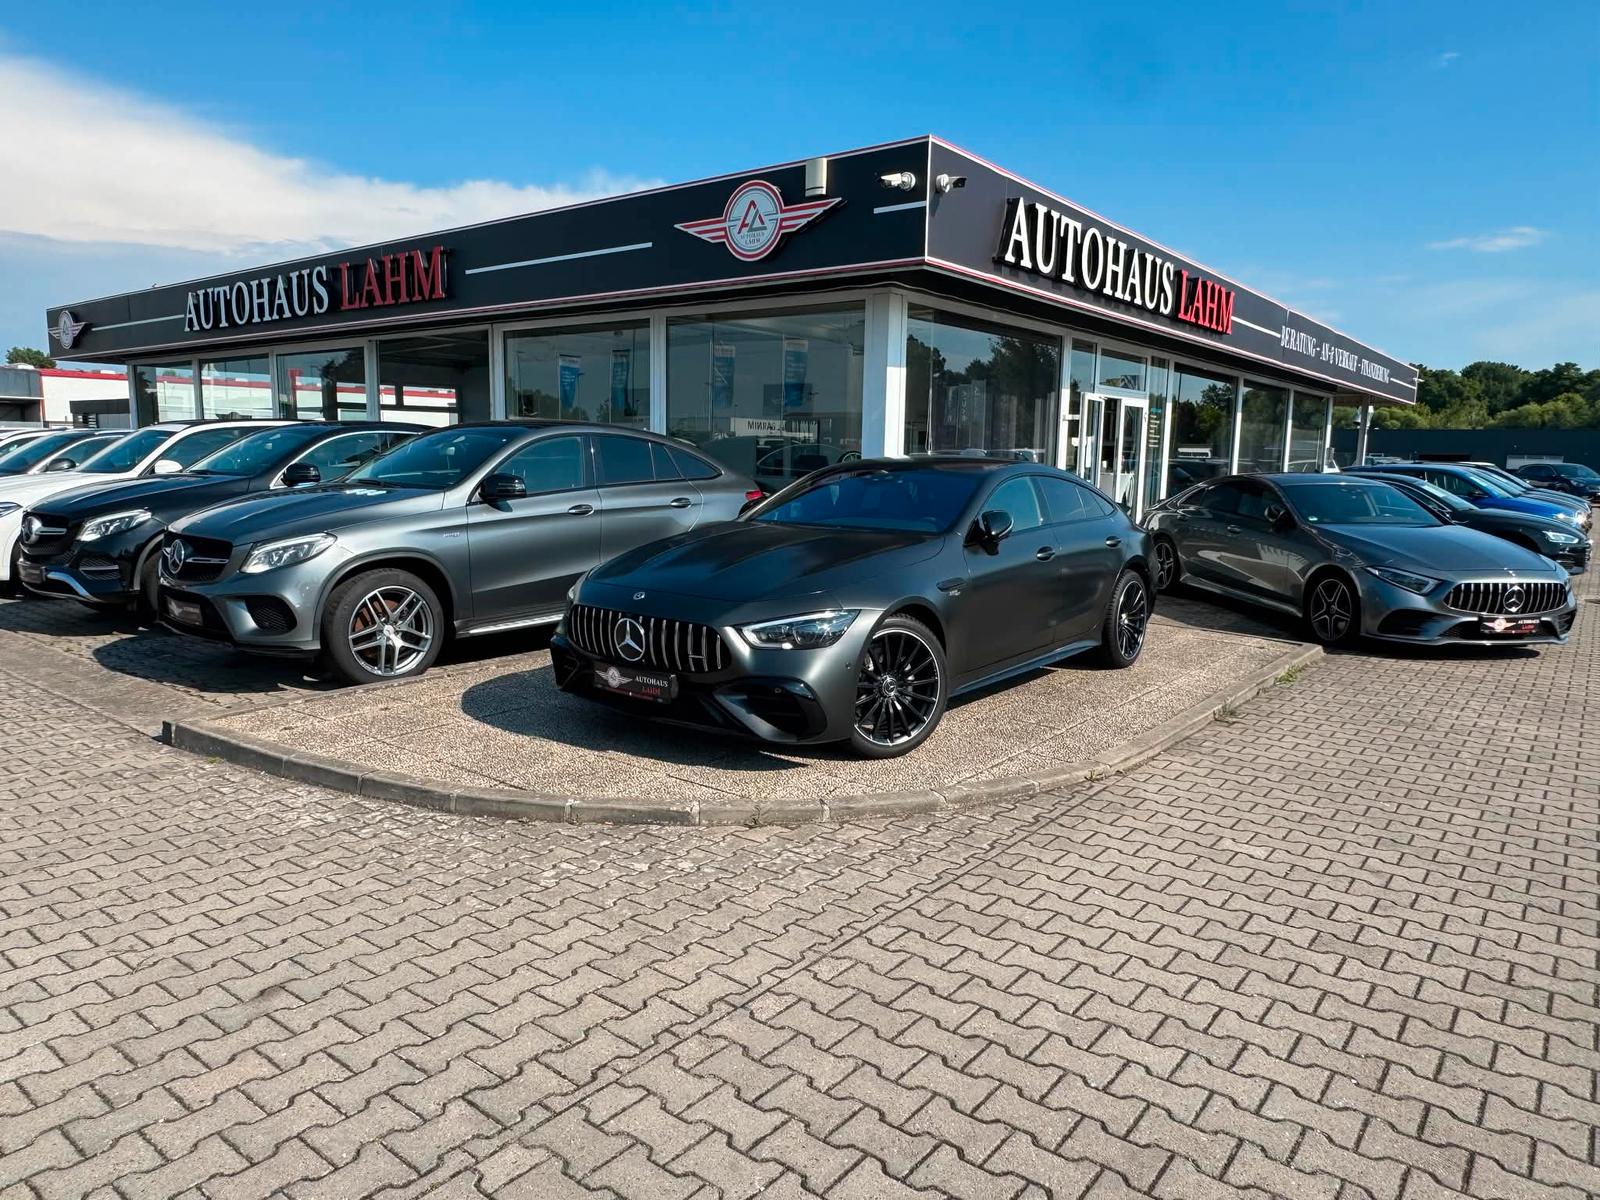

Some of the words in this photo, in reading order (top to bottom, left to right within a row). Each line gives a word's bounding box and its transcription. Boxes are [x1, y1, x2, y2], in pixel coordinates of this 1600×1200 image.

[184, 265, 329, 332] AUTOHAUS
[338, 246, 446, 310] LAHM
[1005, 197, 1174, 315] AUTOHAUS
[1178, 268, 1235, 335] LAHM
[1281, 325, 1316, 357] BERATUNG
[634, 675, 669, 687] AUTOHAUS
